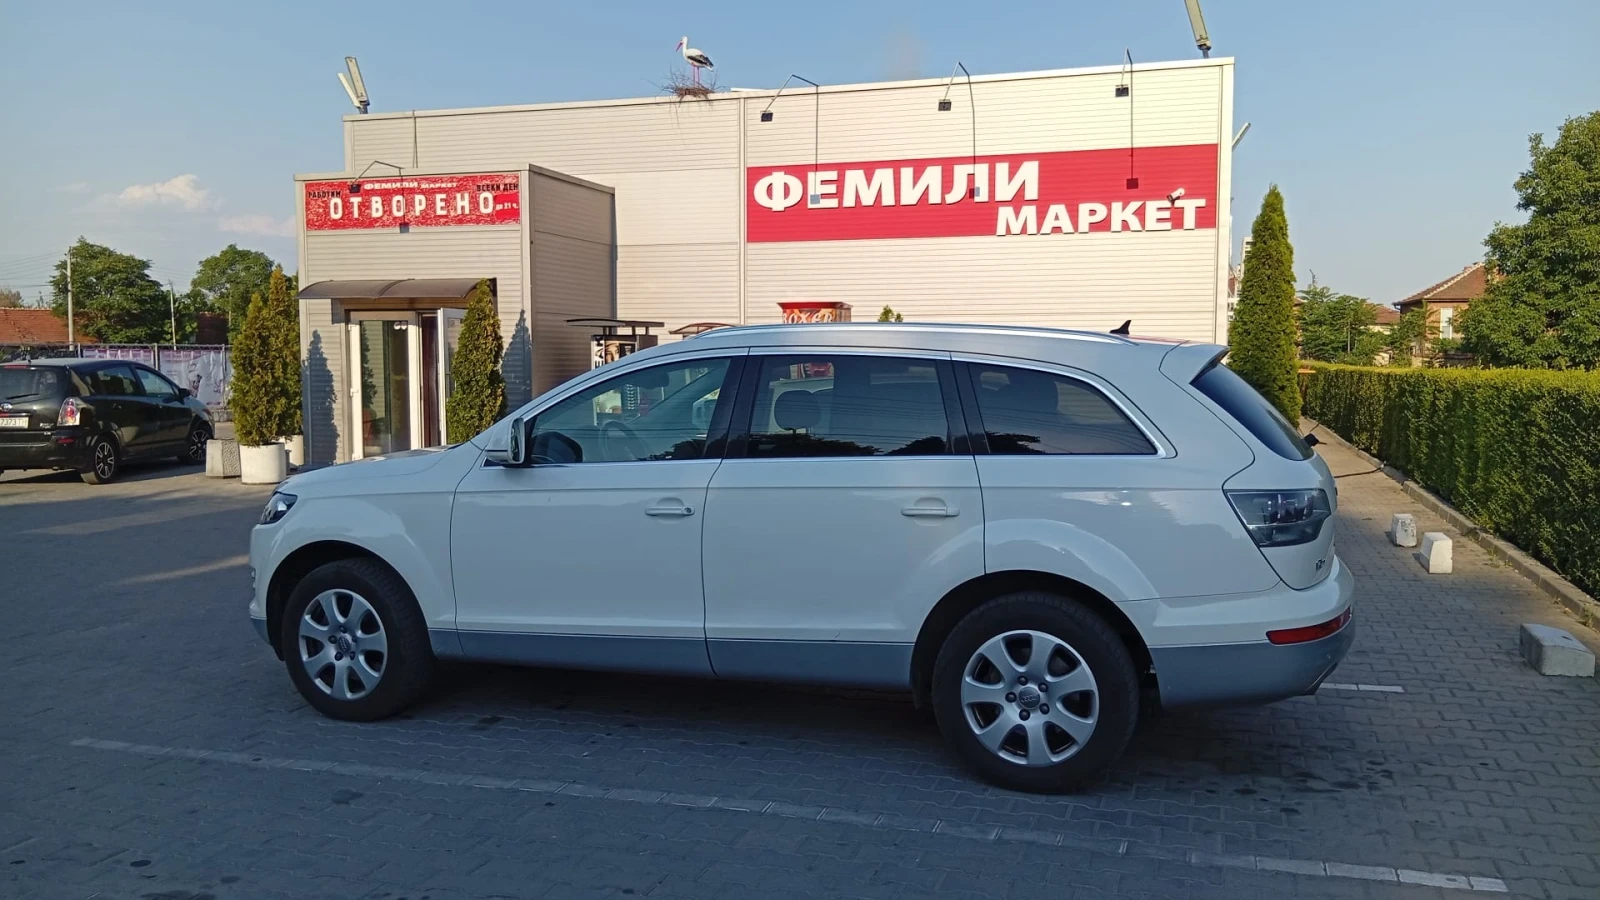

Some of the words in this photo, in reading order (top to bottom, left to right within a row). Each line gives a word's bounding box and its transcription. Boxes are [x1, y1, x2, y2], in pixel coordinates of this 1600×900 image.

[363, 182, 418, 190] ФЕМИЛИ
[476, 184, 501, 192] ВСЕКИ
[502, 183, 519, 192] ДЕН
[753, 160, 1040, 212] ФЕМИЛИ
[329, 191, 494, 220] ОТВОРЕНО
[995, 197, 1207, 236] МАРКЕТ
